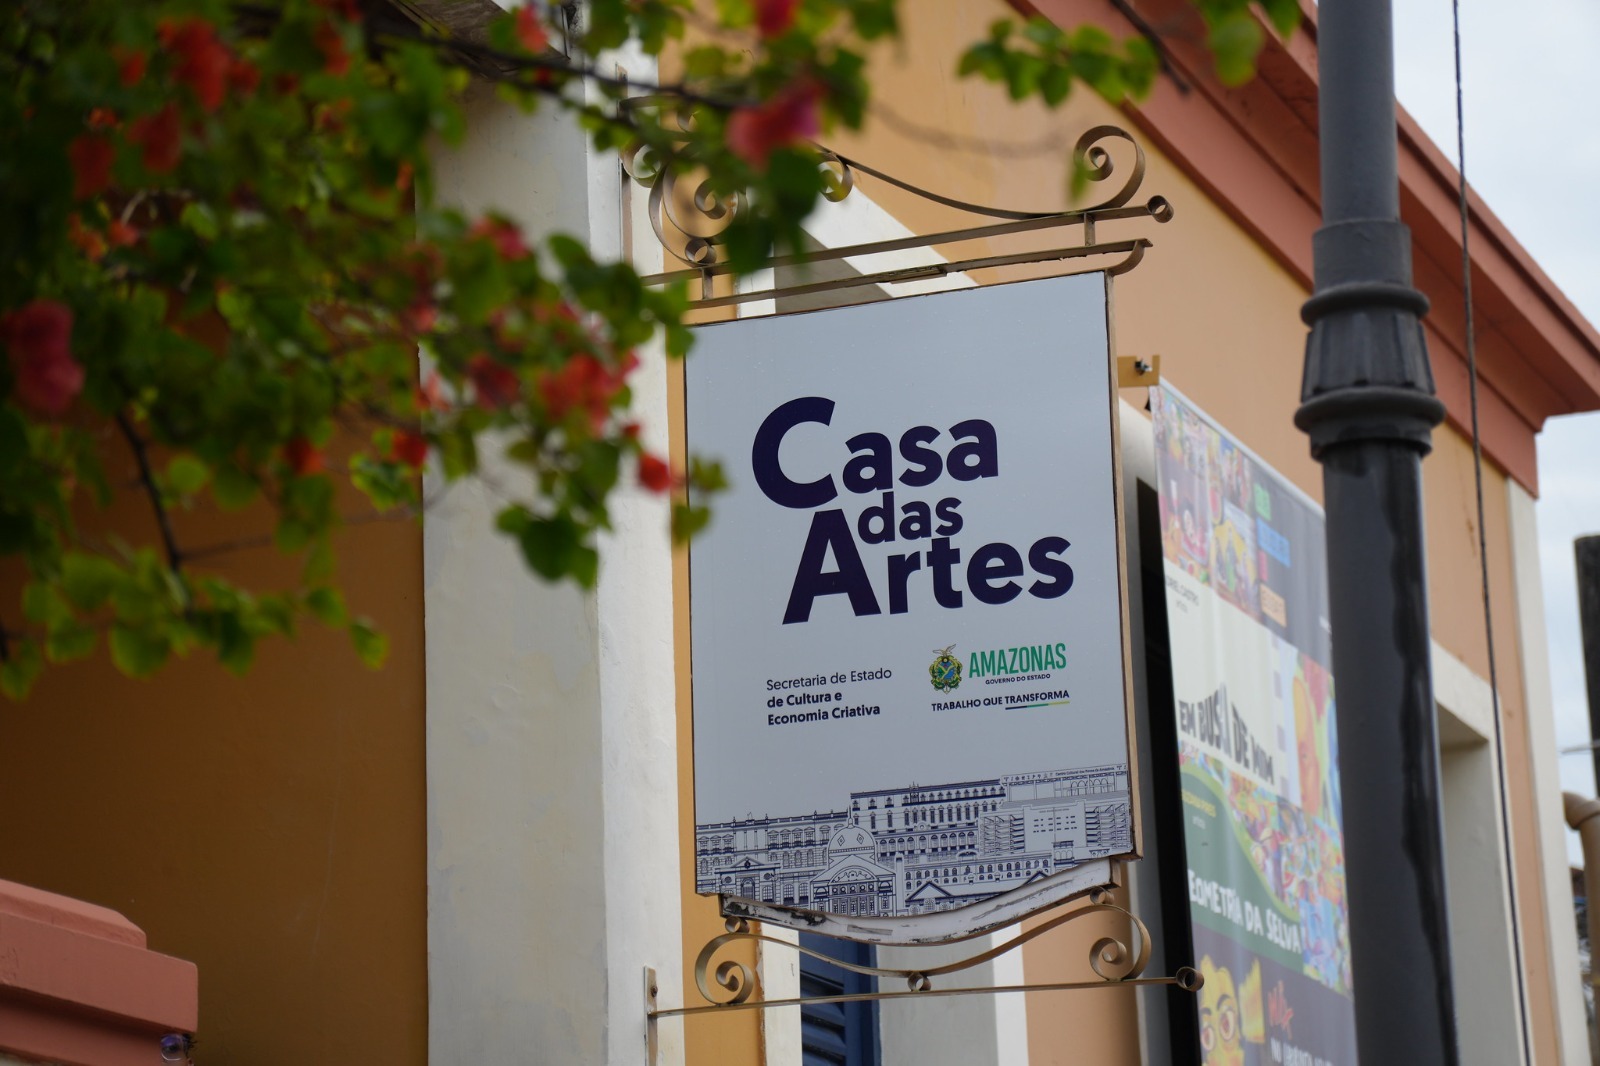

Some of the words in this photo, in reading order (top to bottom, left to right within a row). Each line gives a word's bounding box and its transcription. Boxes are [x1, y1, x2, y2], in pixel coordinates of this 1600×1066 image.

[752, 396, 999, 509] Casa
[857, 491, 964, 544] das
[782, 508, 1074, 625] Artes
[766, 674, 827, 691] Secretaria
[830, 671, 847, 685] de
[850, 667, 892, 682] Estado
[968, 642, 1067, 679] AMAZONAS
[985, 677, 1015, 685] GOVERNO
[1027, 673, 1051, 681] ESTADO
[767, 696, 785, 708] de
[786, 692, 832, 706] Cultura
[834, 692, 843, 701] e
[768, 708, 829, 725] Economia
[831, 704, 881, 719] Criativa
[931, 699, 981, 711] TRABALHO
[983, 696, 1003, 708] QUE
[1005, 690, 1070, 704] TRANSFORMA
[1178, 700, 1197, 738] EM
[1245, 901, 1265, 937] DA
[1265, 907, 1302, 955] SELVA
